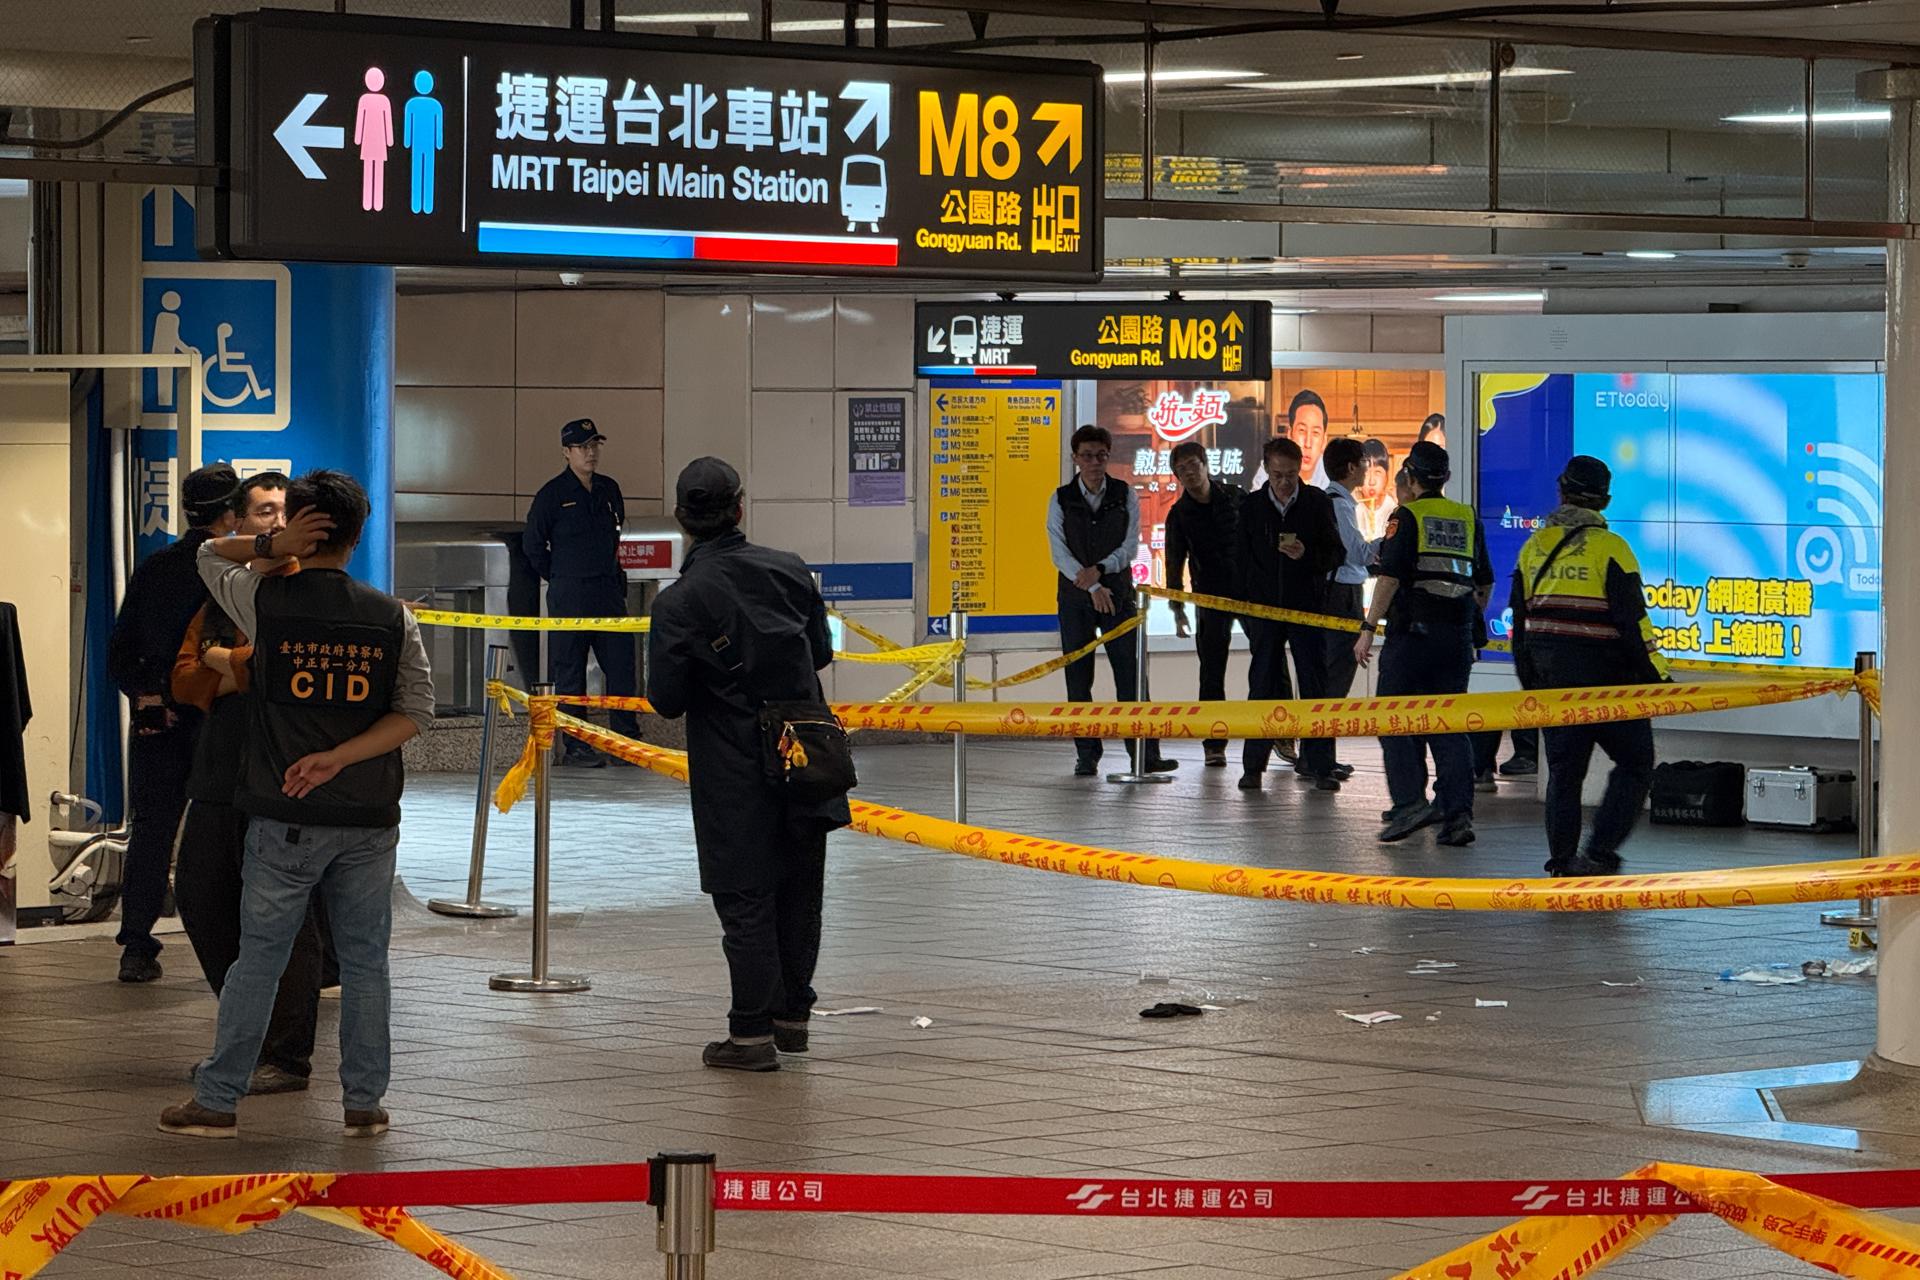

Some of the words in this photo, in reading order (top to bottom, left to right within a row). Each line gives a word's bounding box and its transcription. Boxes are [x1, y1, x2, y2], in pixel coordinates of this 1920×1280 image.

[496, 72, 829, 156] 捷運台北車站
[919, 90, 1021, 180] M8
[492, 154, 560, 191] MRT
[567, 158, 649, 202] Taipei
[658, 162, 725, 199] Main
[732, 165, 828, 204] Station
[940, 189, 1022, 226] 公園路
[1031, 184, 1080, 253] 出口
[916, 228, 993, 252] Gongyuan
[996, 231, 1022, 251] Rd.
[1056, 234, 1080, 252] EXIT
[980, 315, 1023, 345] 捷運
[1098, 315, 1163, 346] 公園路
[1169, 319, 1217, 360] M8
[979, 348, 1010, 365] MRT
[1071, 349, 1138, 369] Gongyuan
[1141, 350, 1163, 366] Rd.
[1223, 345, 1241, 372] 出口
[1151, 391, 1229, 429] 統一麵
[1595, 391, 1669, 412] ETtoday
[1133, 448, 1244, 476] 熟悉美味
[1428, 532, 1466, 549] POLICE
[1529, 565, 1589, 580] PLICE
[1856, 573, 1880, 585] Toda
[1643, 580, 1702, 616] oday
[1707, 578, 1812, 617] 網路廣播
[279, 640, 384, 661] 臺北市政府警察局
[1654, 621, 1701, 651] cast
[1705, 620, 1801, 656] 上線啦！
[292, 657, 371, 673] 中正第一分局
[714, 1179, 823, 1202] 捷運公司
[1120, 1186, 1274, 1209] 台北捷運公司
[1566, 1186, 1691, 1207] 台北捷運公
